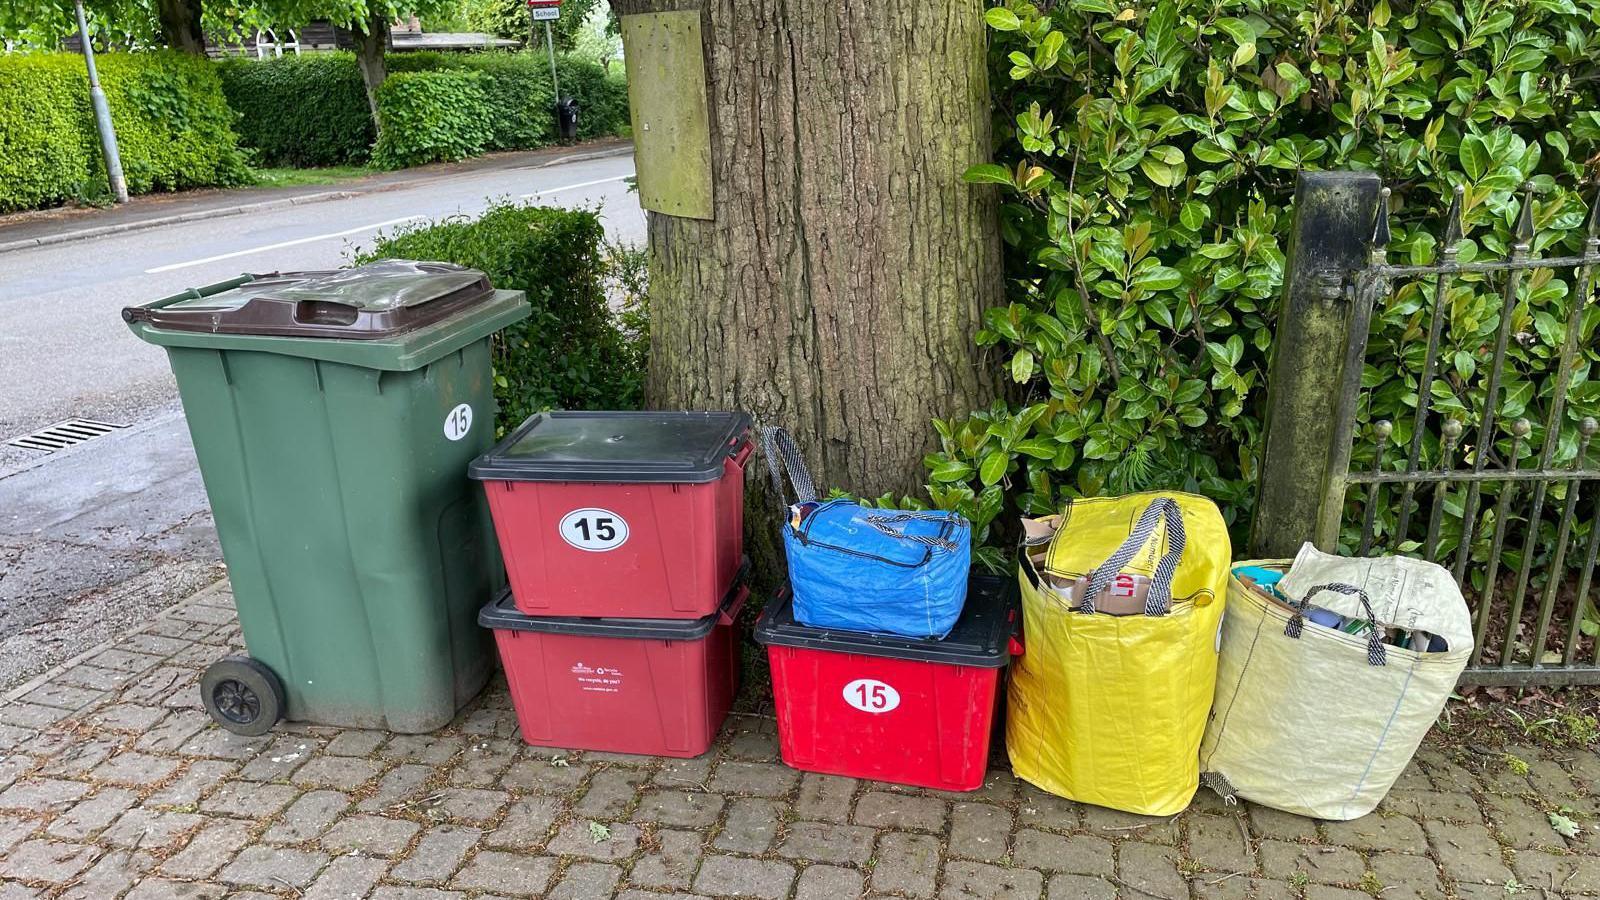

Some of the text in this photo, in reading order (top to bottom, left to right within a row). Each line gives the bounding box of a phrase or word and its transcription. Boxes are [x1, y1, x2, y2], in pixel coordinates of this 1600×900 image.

[451, 407, 467, 436] 15
[574, 517, 616, 541] 15
[856, 683, 887, 709] 15
